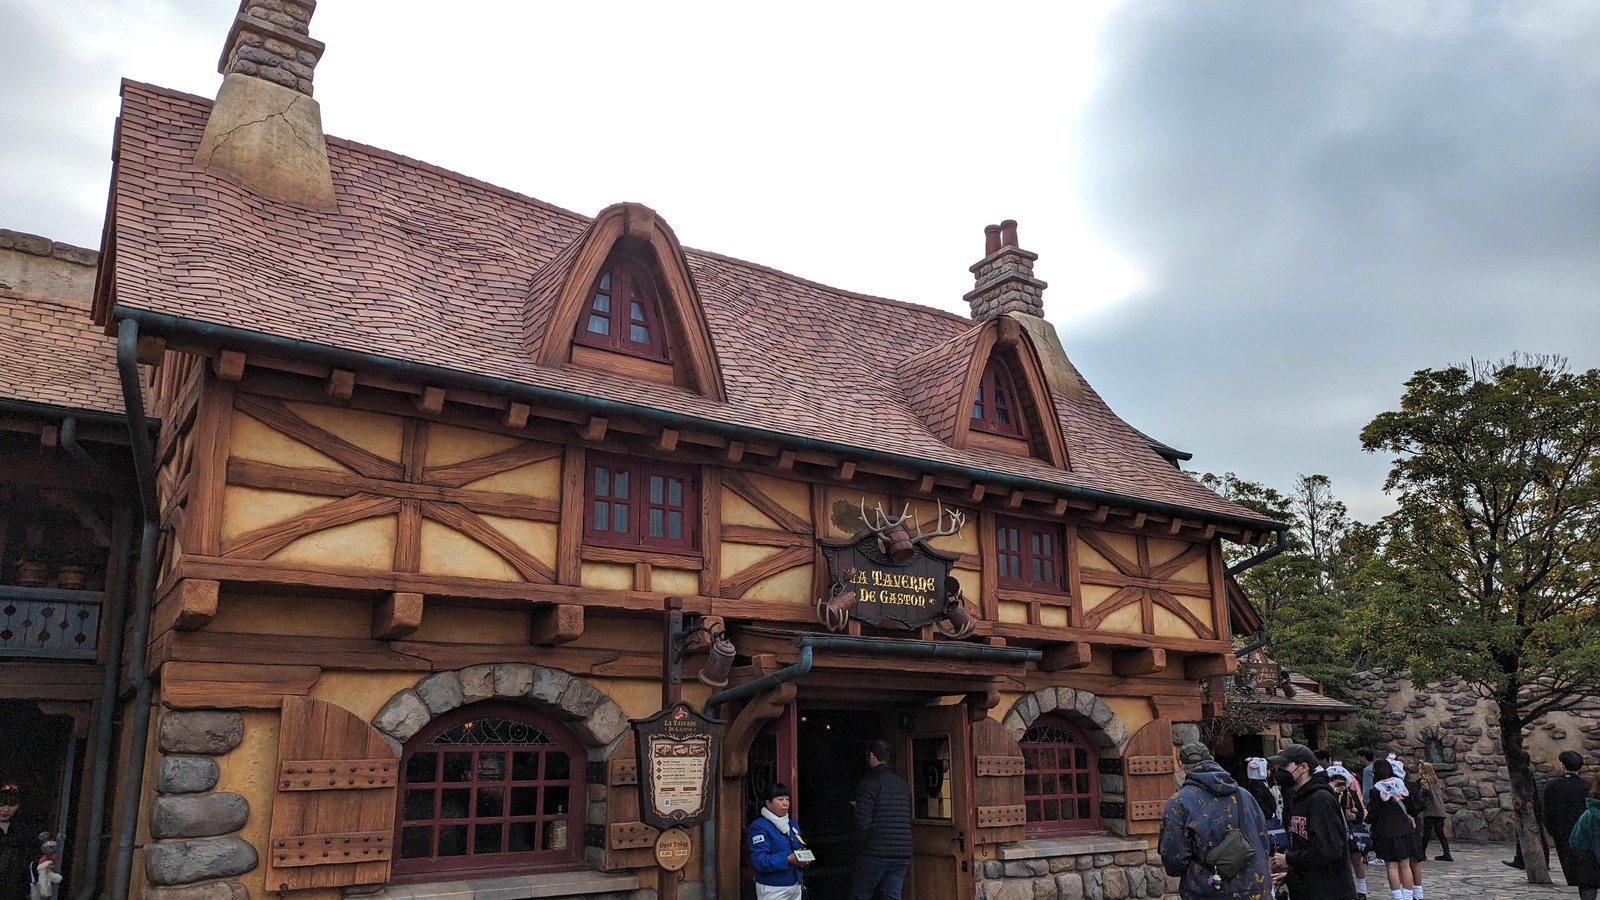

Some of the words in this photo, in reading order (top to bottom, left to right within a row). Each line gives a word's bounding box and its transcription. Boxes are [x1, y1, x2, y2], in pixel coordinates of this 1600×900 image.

[872, 570, 935, 593] TAVERNE
[859, 588, 876, 603] DE
[880, 590, 926, 608] GASTON
